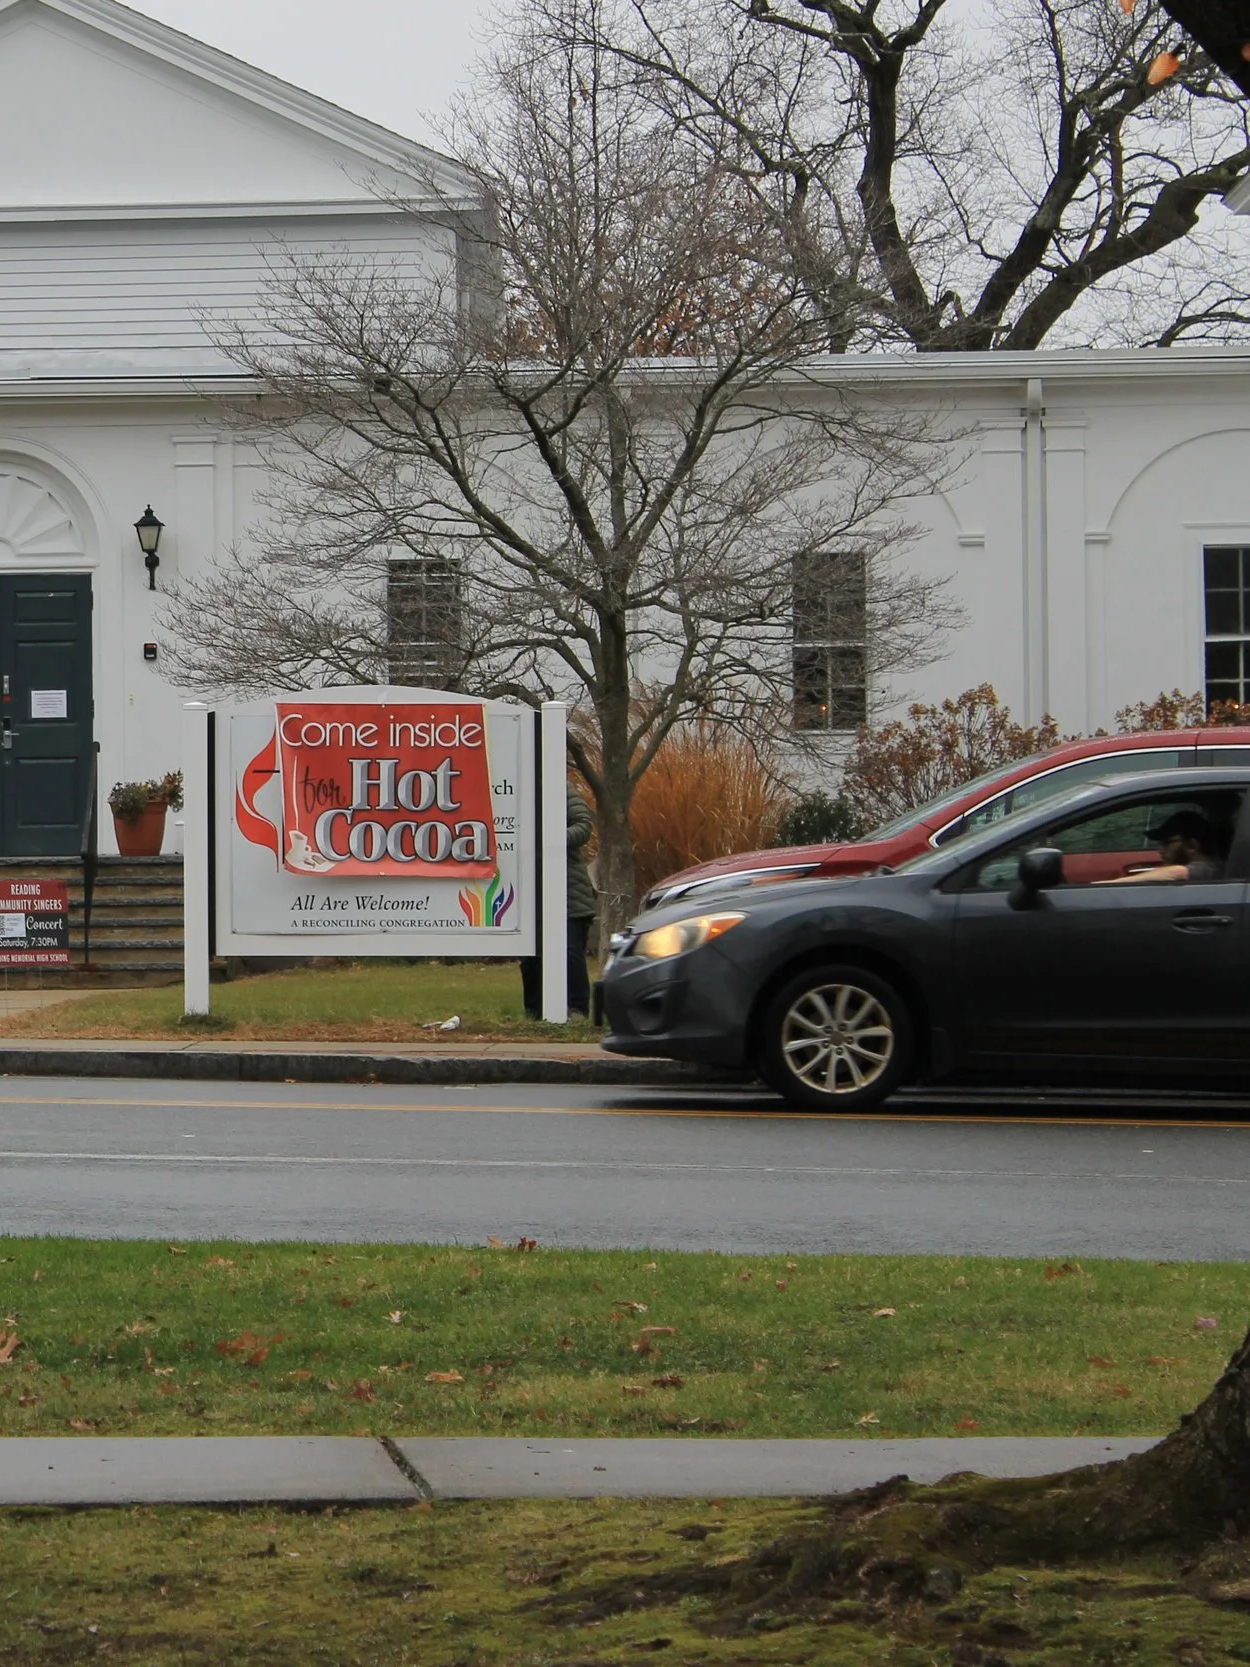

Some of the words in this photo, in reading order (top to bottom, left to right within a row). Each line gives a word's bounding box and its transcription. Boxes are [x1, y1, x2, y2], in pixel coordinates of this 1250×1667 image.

[280, 713, 379, 747] Come
[389, 714, 483, 747] inside
[298, 765, 347, 814] for
[347, 755, 462, 813] Hot
[314, 808, 494, 864] Cocoa
[11, 884, 41, 895] READING
[34, 900, 62, 910] SINGERS
[291, 895, 316, 911] All
[319, 896, 349, 911] Are
[355, 895, 430, 911] Welcome!
[26, 916, 63, 930] Concert
[291, 919, 298, 928] A
[302, 919, 376, 928] RECONCILING
[379, 919, 465, 928] CONGREGATION
[31, 938, 58, 947] 7:30PM
[11, 954, 35, 962] MEMORIAL
[36, 954, 49, 962] HIGH
[50, 954, 68, 962] SCHOOL
